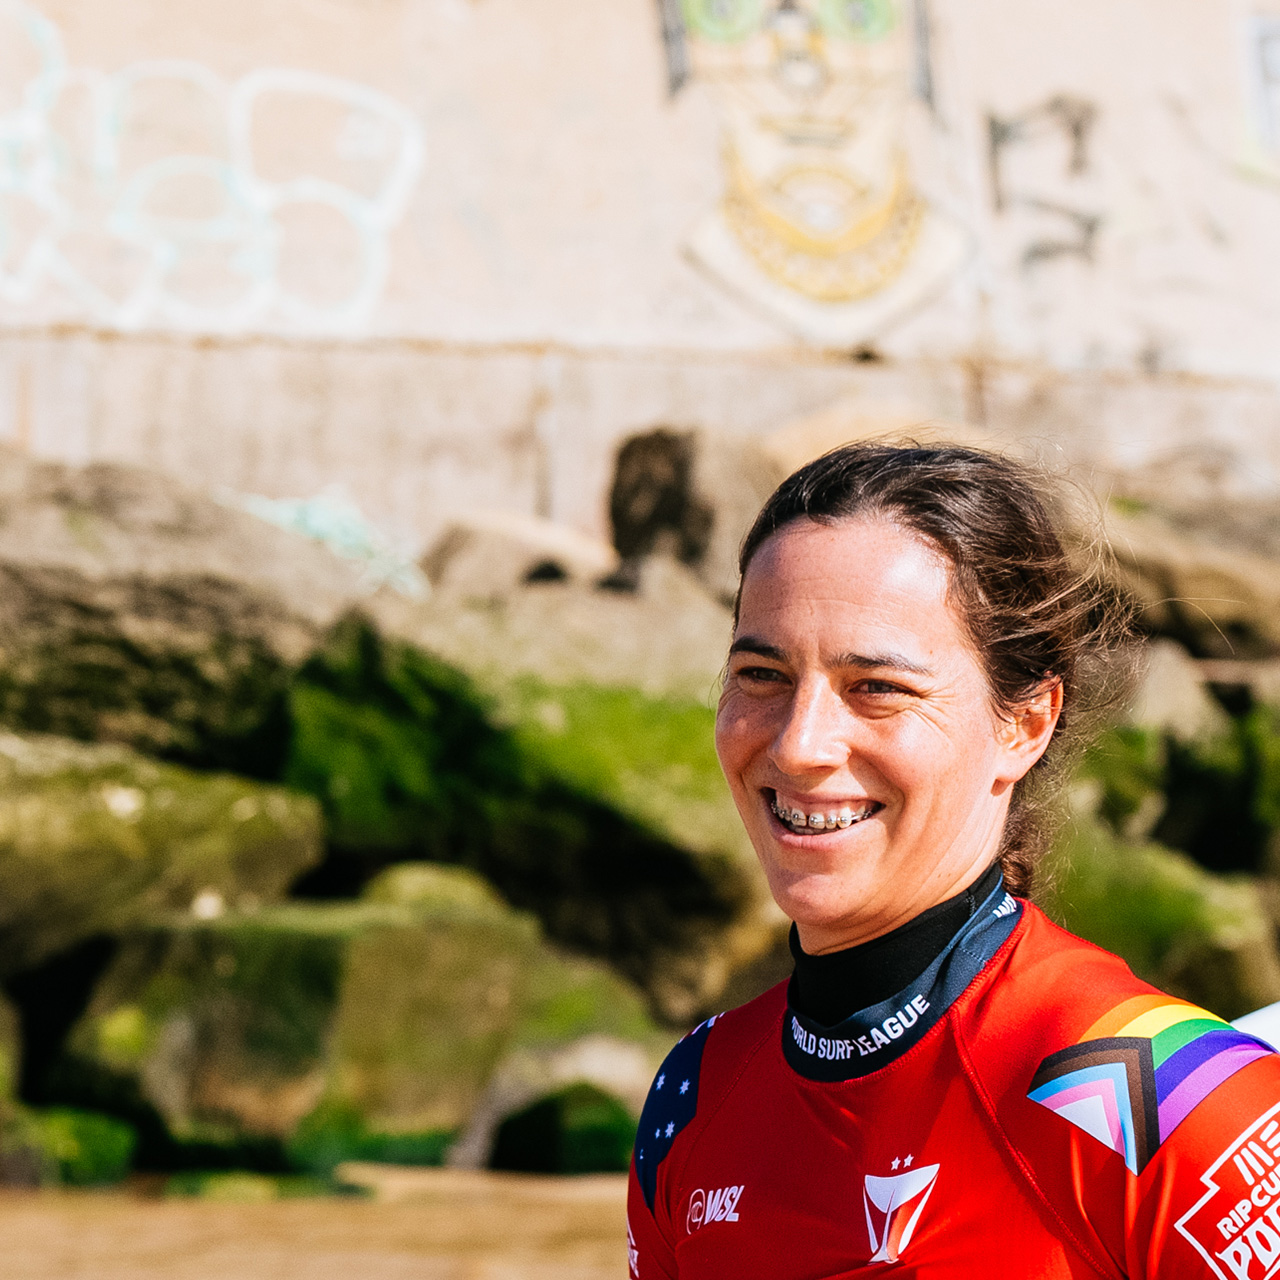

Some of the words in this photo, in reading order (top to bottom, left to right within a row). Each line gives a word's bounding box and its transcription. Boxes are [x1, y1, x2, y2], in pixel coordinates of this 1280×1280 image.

[817, 1037, 855, 1060] SURF
[852, 994, 931, 1057] LEAGUE
[703, 1184, 746, 1224] WSL
